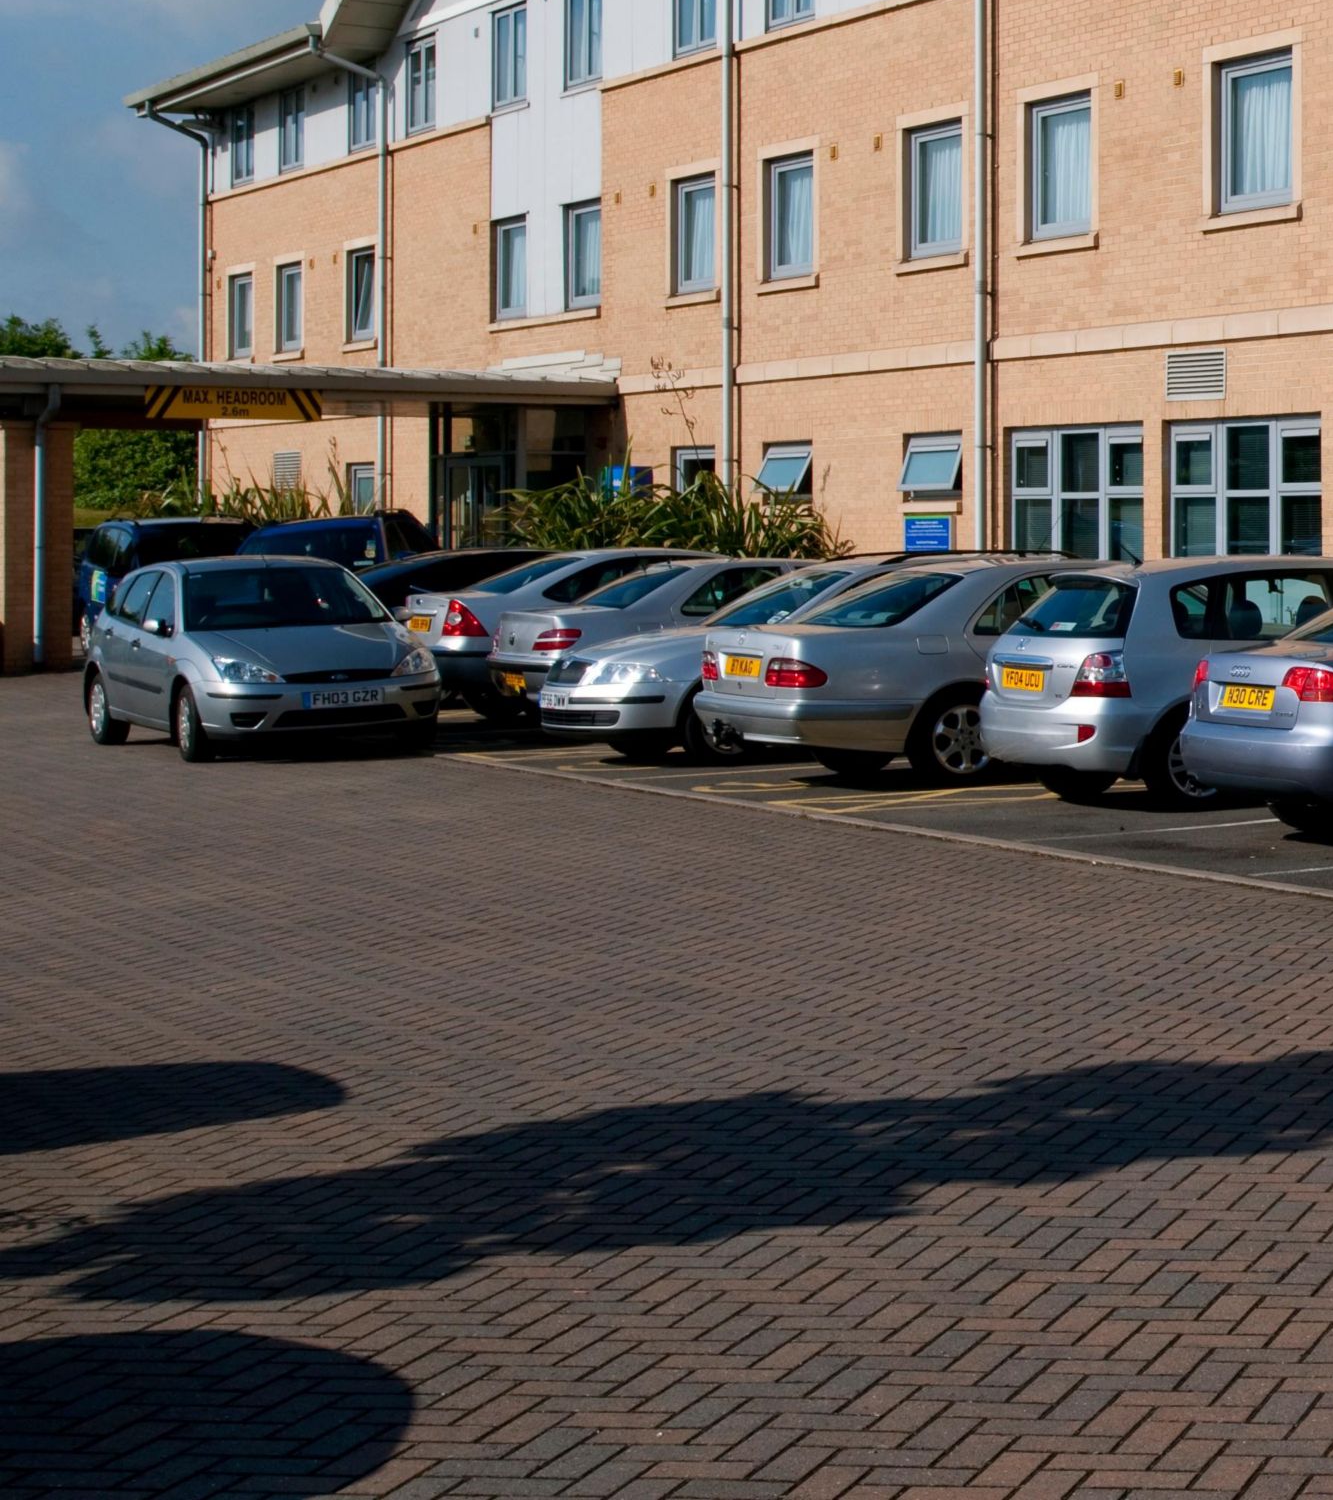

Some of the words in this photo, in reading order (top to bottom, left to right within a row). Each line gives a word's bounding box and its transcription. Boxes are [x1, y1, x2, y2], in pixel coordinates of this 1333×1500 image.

[182, 388, 213, 405] MAX.
[216, 390, 287, 406] HEADROOM
[221, 406, 249, 417] 2.6m
[1248, 689, 1270, 707] CRE
